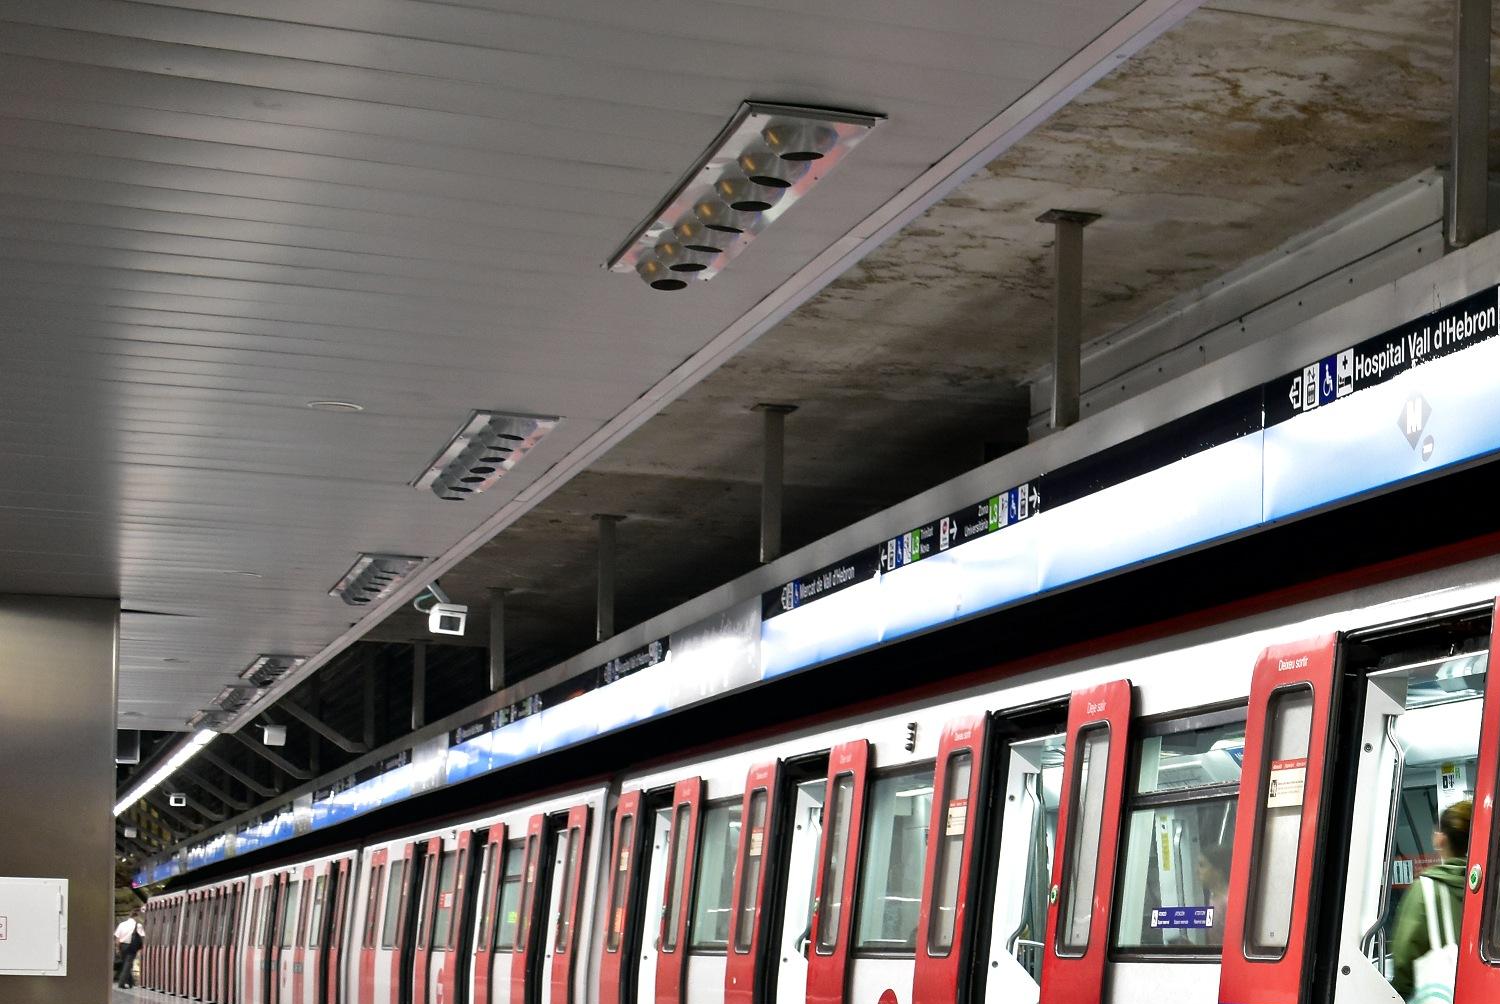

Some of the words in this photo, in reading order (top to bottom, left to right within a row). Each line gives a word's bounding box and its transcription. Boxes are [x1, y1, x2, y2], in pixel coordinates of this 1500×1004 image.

[1355, 337, 1405, 380] Hospital
[1408, 327, 1431, 359] Vall
[1434, 307, 1496, 349] d'Hebron
[989, 504, 998, 525] L3
[1278, 659, 1295, 672] Deixeu
